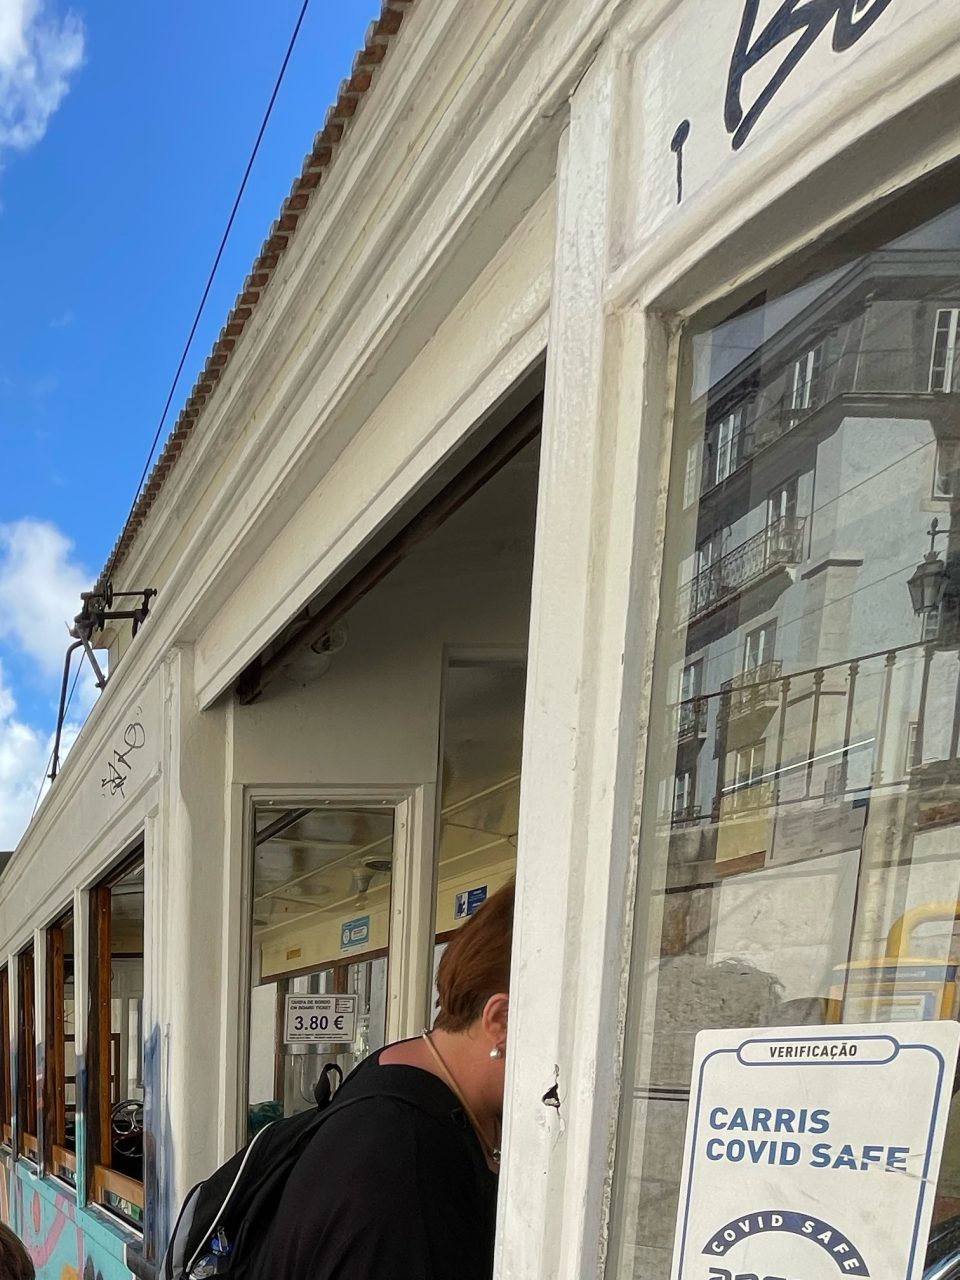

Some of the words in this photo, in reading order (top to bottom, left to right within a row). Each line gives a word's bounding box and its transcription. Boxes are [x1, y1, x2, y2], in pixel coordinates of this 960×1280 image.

[294, 1015, 328, 1030] 3.80
[334, 1015, 344, 1030] €
[769, 1042, 858, 1060] VERIFICAÇÃO
[709, 1107, 831, 1134] CARRIS
[706, 1138, 801, 1166] COVID
[809, 1143, 910, 1172] SAFE
[711, 1214, 783, 1253] COVID
[801, 1220, 860, 1270] SAFE
